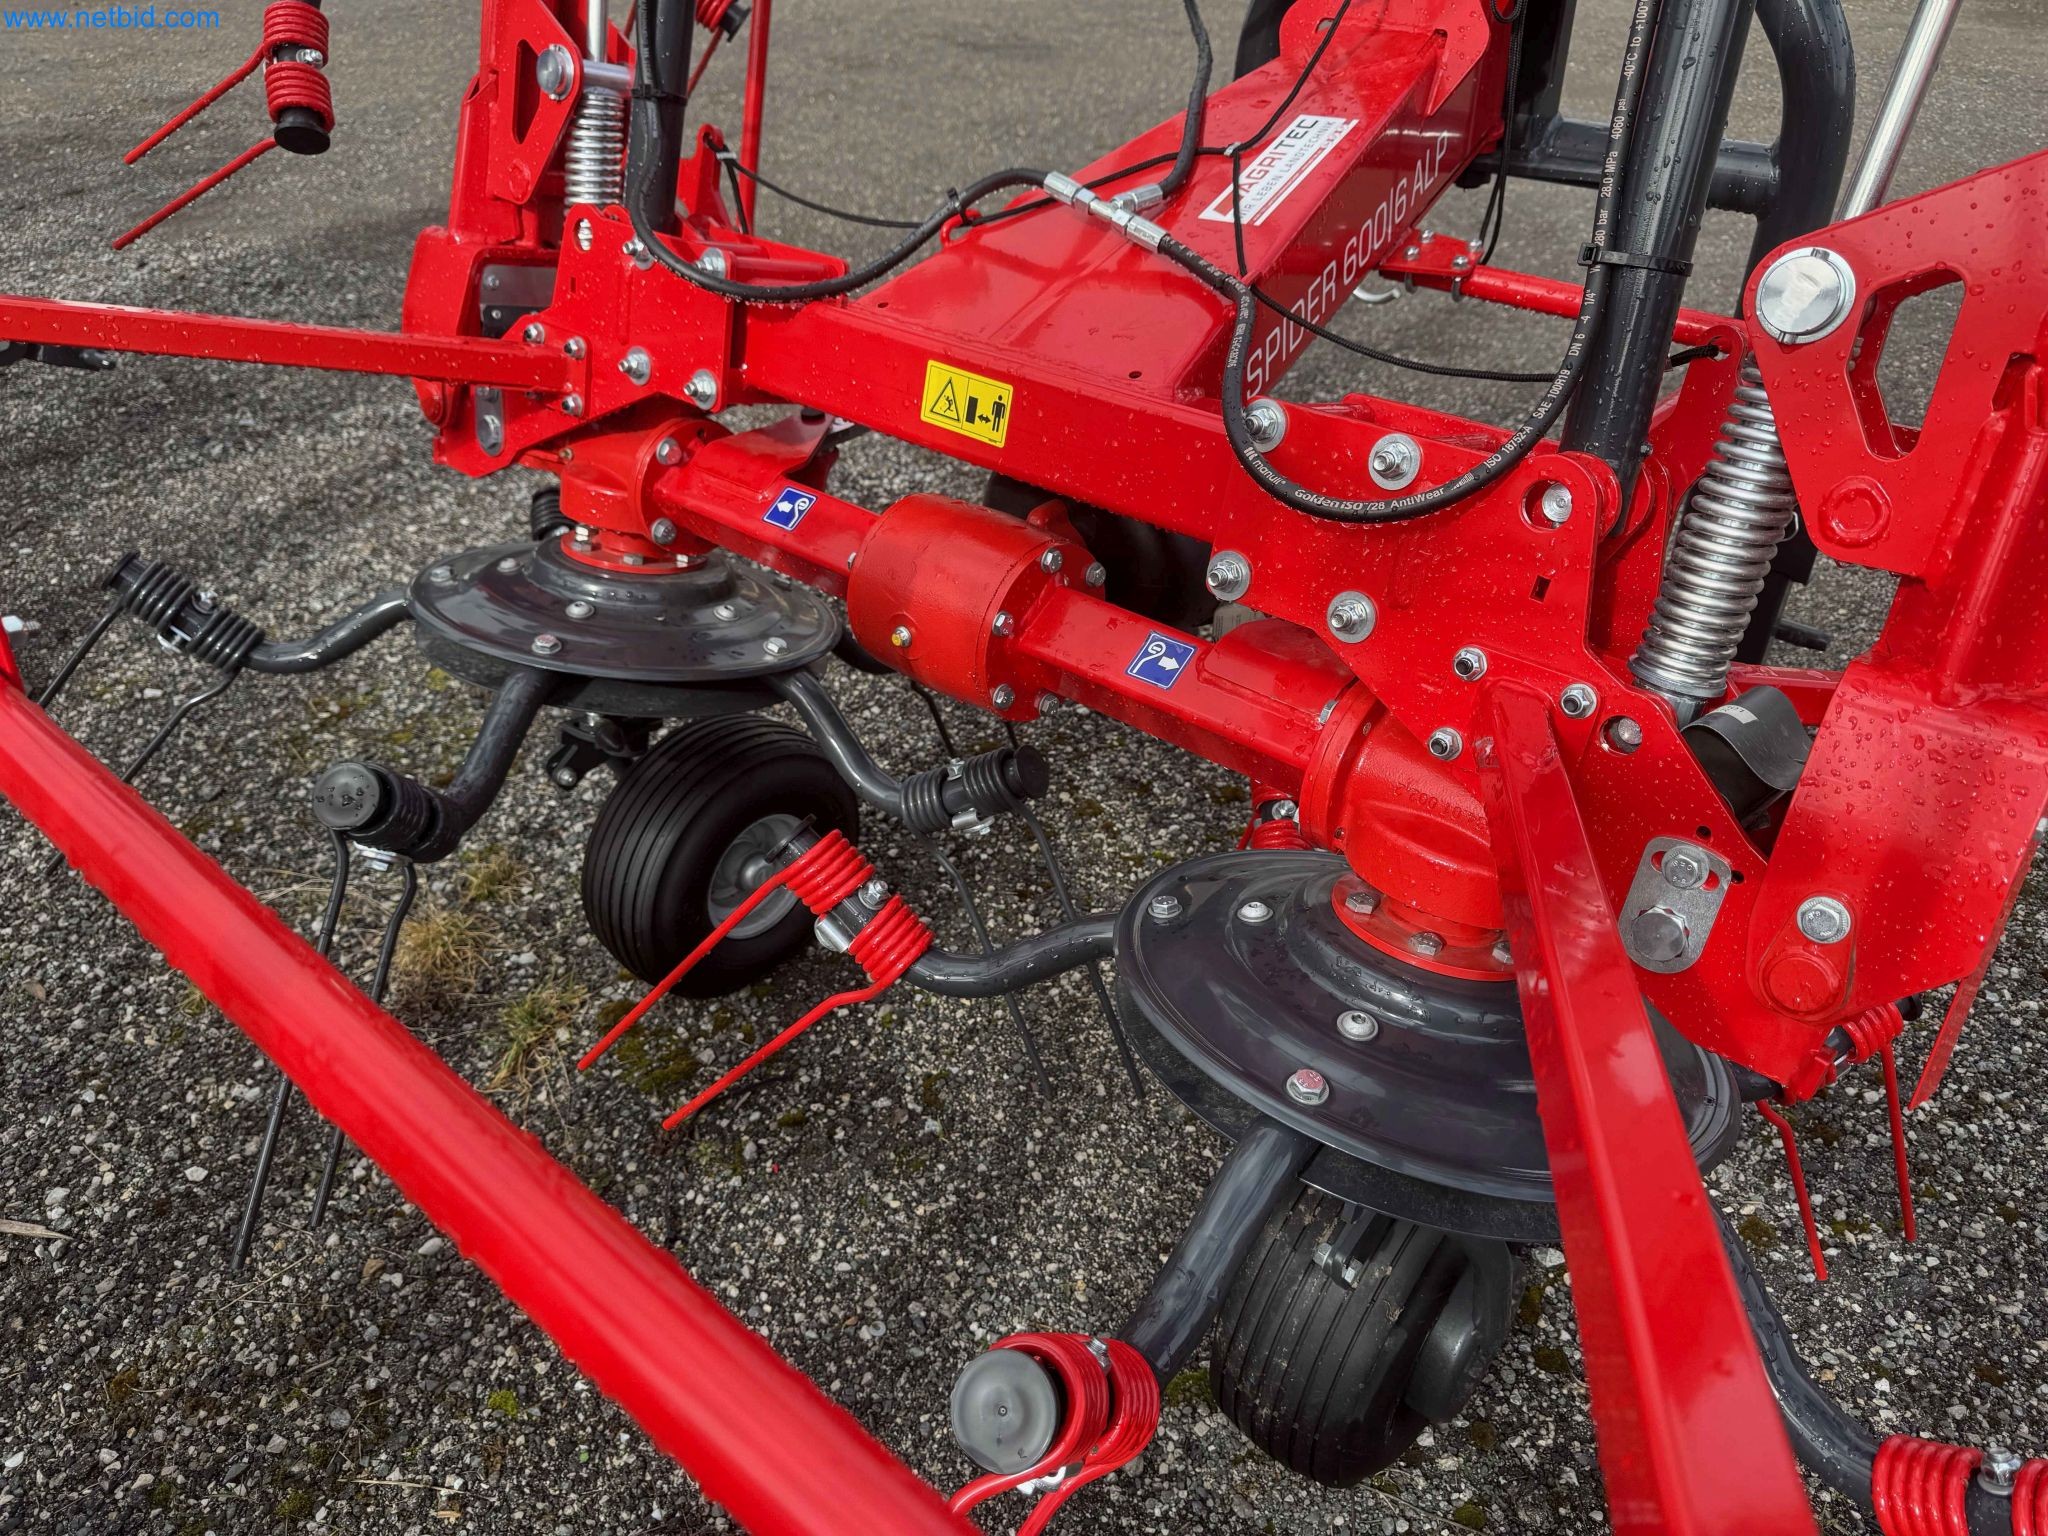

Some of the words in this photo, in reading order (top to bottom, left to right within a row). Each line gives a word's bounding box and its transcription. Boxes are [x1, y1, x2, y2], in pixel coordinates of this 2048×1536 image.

[1630, 36, 1641, 47] to
[1618, 98, 1627, 111] psi
[1611, 116, 1625, 140] 4060
[1604, 151, 1618, 173] MPa
[1253, 173, 1283, 202] LEBEN
[1601, 177, 1614, 198] 28.0
[1597, 209, 1609, 226] bar
[1594, 230, 1605, 247] 280
[1247, 260, 1336, 400] SPIDER
[1410, 132, 1447, 207] ALP
[1568, 342, 1582, 357] DN
[1548, 369, 1570, 401] 100R19
[1532, 401, 1552, 420] SAE
[1501, 425, 1534, 454] 18752-A
[1484, 454, 1502, 469] ISO
[1390, 487, 1445, 509] AntiWear
